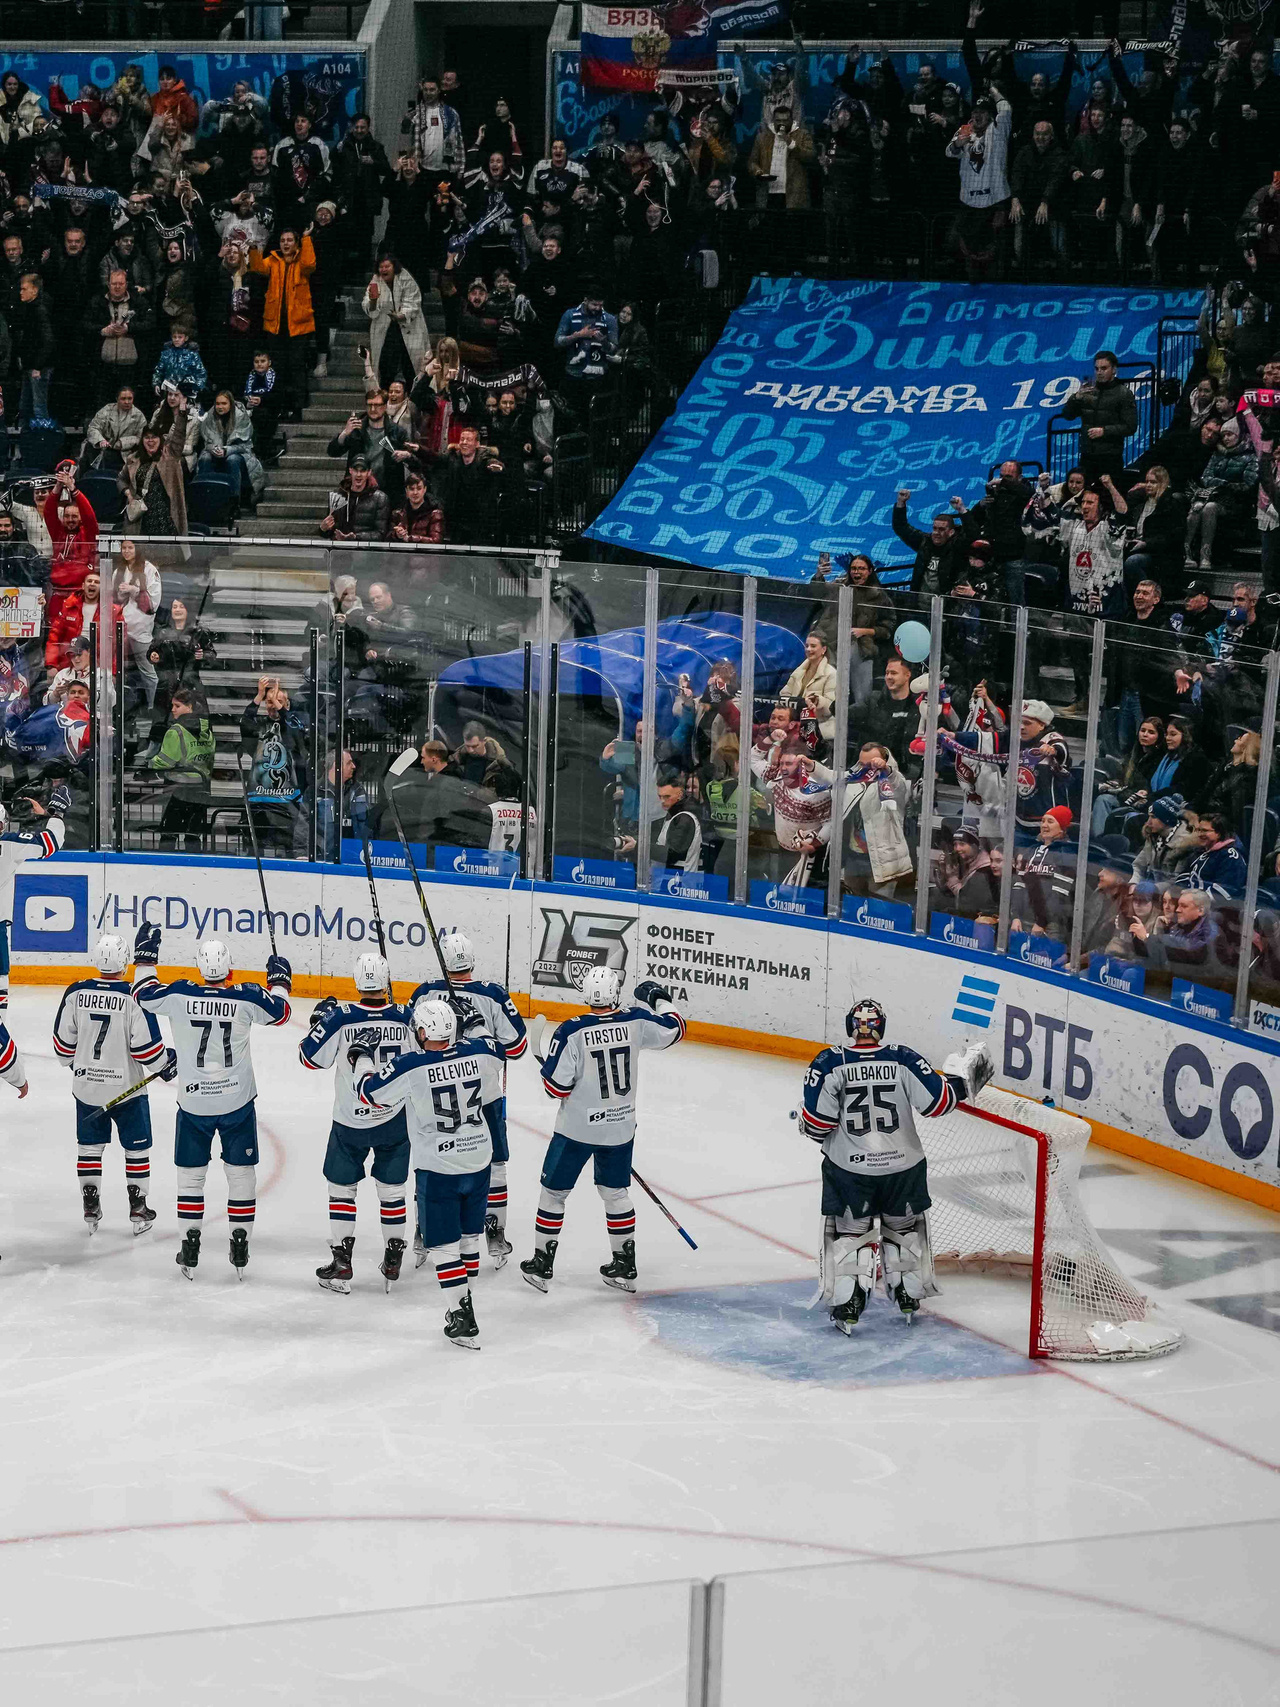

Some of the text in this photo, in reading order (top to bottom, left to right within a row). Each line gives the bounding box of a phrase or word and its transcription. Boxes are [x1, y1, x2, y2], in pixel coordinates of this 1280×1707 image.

[322, 63, 351, 75] A104
[565, 64, 580, 74] A1
[621, 68, 659, 78] РОСС
[992, 290, 1208, 319] MOSCOW
[743, 381, 978, 401] ДИНАМО
[772, 395, 988, 414] МОСКВА
[649, 523, 918, 564] MOSC
[255, 785, 295, 797] Динамо
[373, 856, 406, 868] ГАЗПРОМ
[467, 863, 499, 875] ГАЗПРОМ
[584, 874, 616, 887] ГАЗПРОМ
[678, 887, 709, 900] ГАЗПРОМ
[777, 901, 806, 914] ГАЗПРОМ
[867, 916, 895, 930] ГАЗПРОМ
[646, 923, 715, 946] ФОНБЕТ
[953, 935, 979, 949] ГАЗПРОМ
[566, 949, 599, 960] FONBET
[646, 943, 811, 982] КОНТИНЕНТАЛЬНАЯ
[1028, 954, 1052, 969] ГАЗПРОМ
[538, 962, 558, 972] 2022
[646, 962, 749, 991] ХОККЕЙНАЯ
[1108, 976, 1131, 993] ГАЗПРОМ
[78, 991, 126, 1013] BURENOV
[186, 1001, 238, 1018] LETUNOV
[1192, 1002, 1217, 1020] ГАЗПРОМ
[89, 1012, 111, 1060] 7
[344, 1026, 409, 1043] VINRADOV
[584, 1025, 630, 1047] FIRSTOV
[190, 1019, 233, 1068] 71
[1002, 1003, 1094, 1101] ВТБ
[427, 1058, 480, 1084] BELEVICH
[590, 1045, 632, 1100] 10
[846, 1065, 897, 1082] ULBAKOV
[430, 1077, 483, 1134] 93
[844, 1083, 900, 1137] 35
[1163, 1042, 1280, 1170] СО
